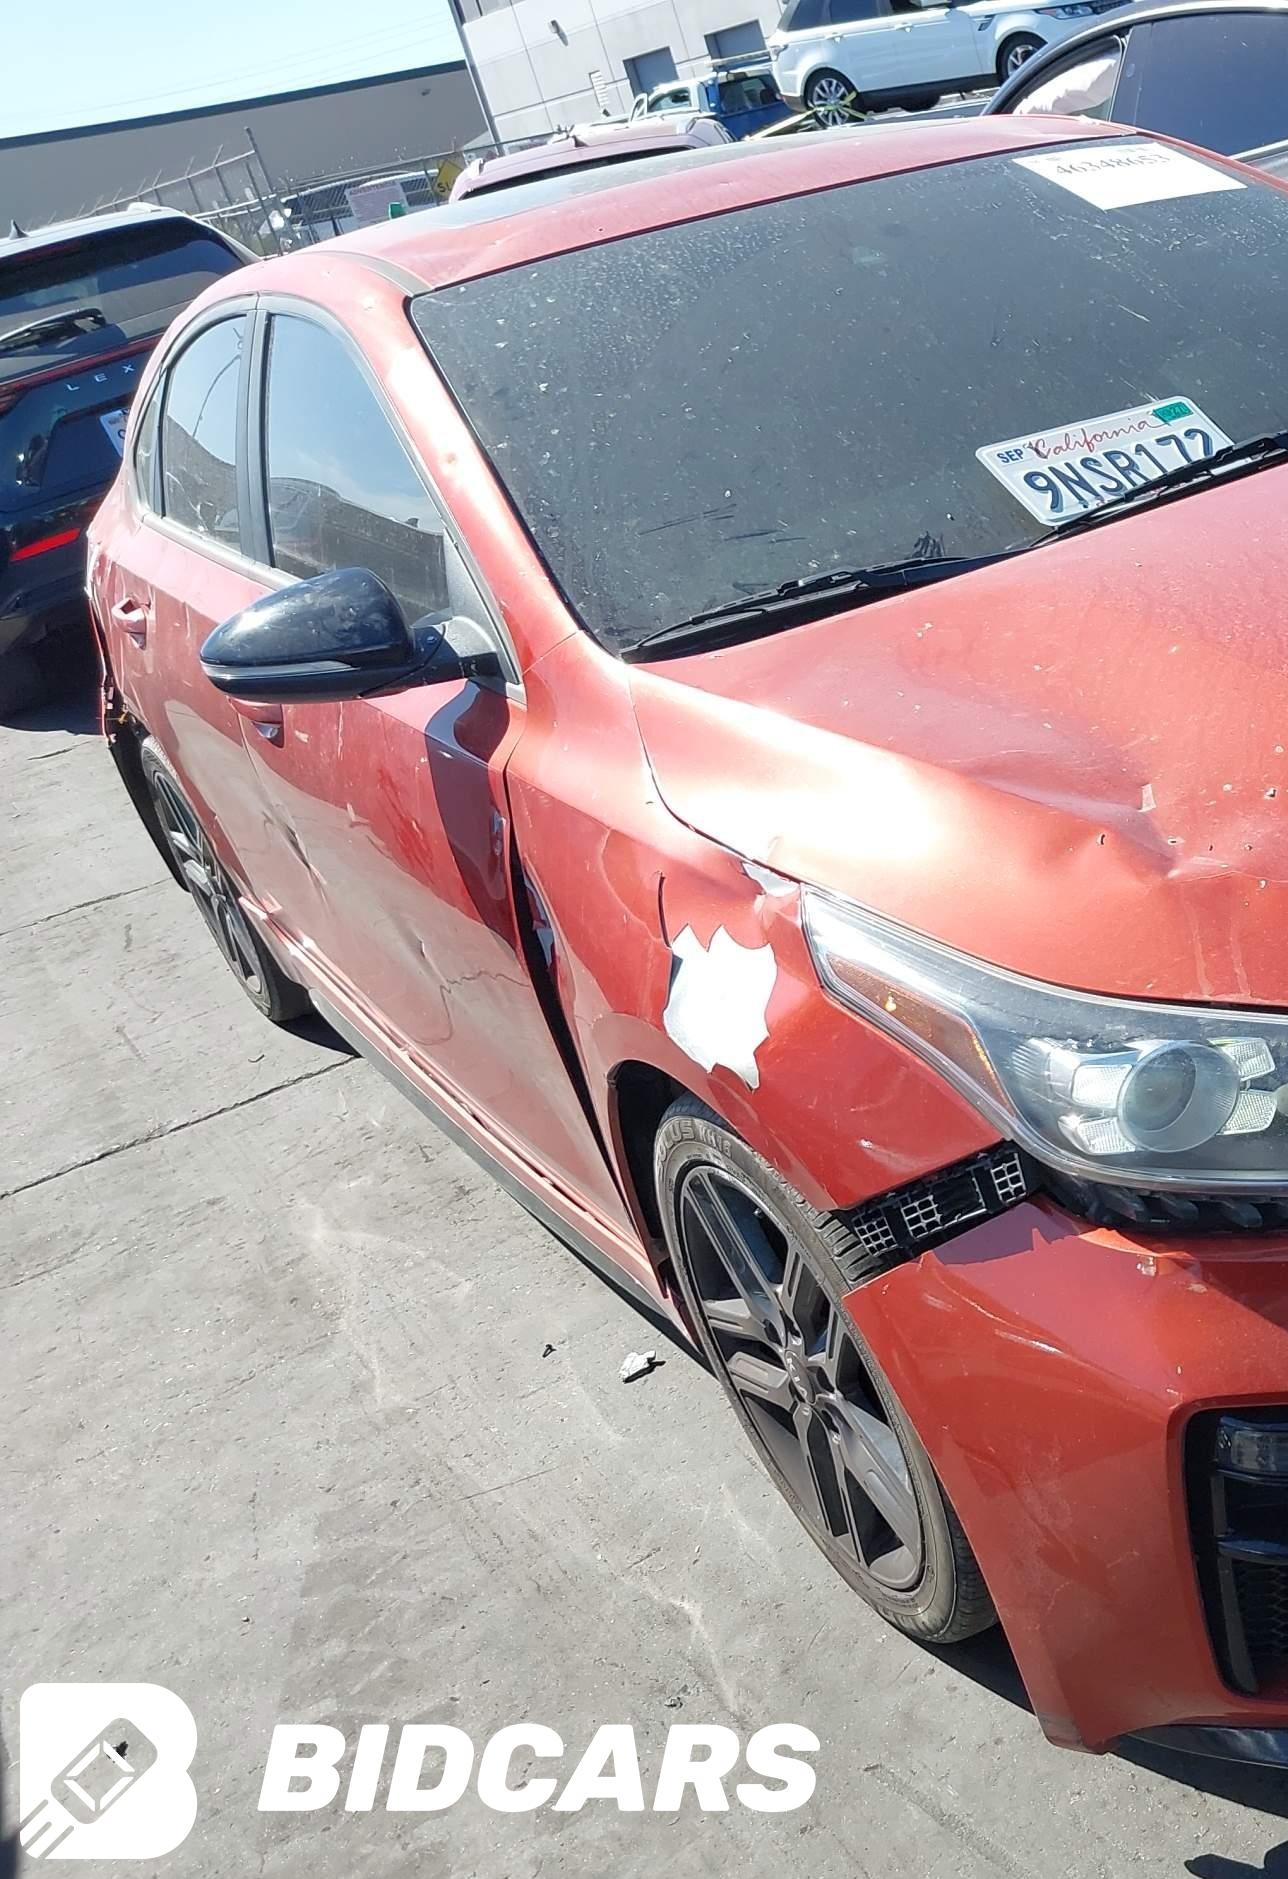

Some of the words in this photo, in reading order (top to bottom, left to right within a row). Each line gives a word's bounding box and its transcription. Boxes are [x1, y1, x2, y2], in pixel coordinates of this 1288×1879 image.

[1056, 154, 1170, 176] 46348653
[1031, 417, 1168, 460] California
[997, 448, 1024, 464] SEP
[1023, 428, 1214, 513] 9NSR172
